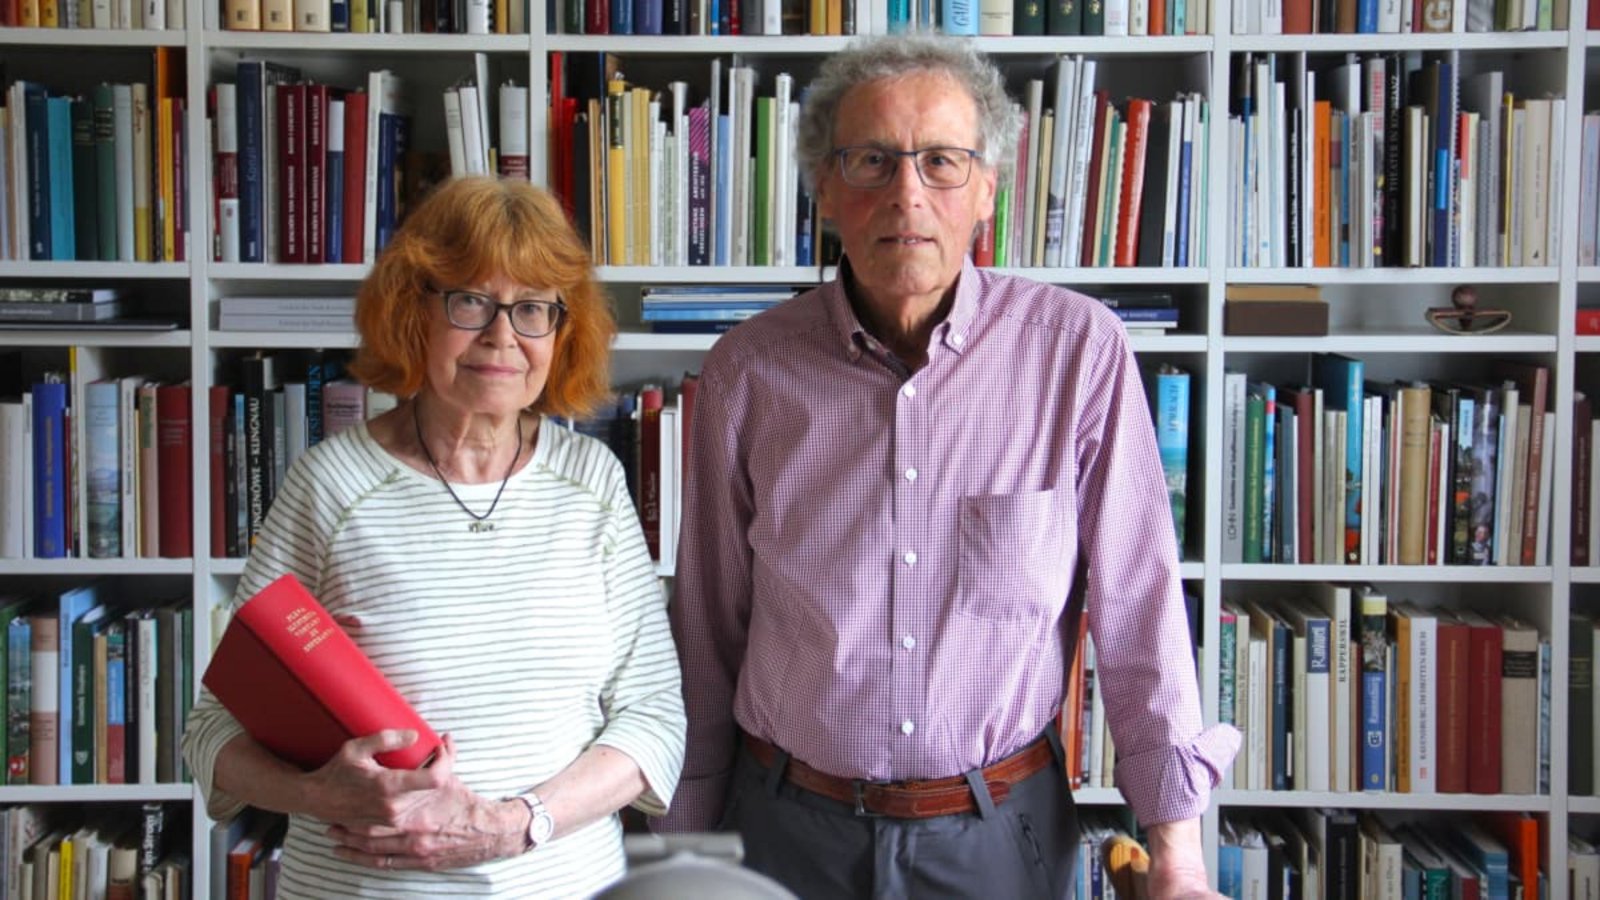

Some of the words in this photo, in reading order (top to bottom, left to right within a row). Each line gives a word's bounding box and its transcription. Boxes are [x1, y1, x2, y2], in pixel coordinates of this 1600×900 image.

[1389, 75, 1400, 129] KONSTANZ
[1388, 143, 1399, 192] THEATER
[249, 397, 260, 456] KLINGNAU
[1228, 513, 1237, 541] LOHN
[1339, 619, 1347, 682] RAPPERSWIL
